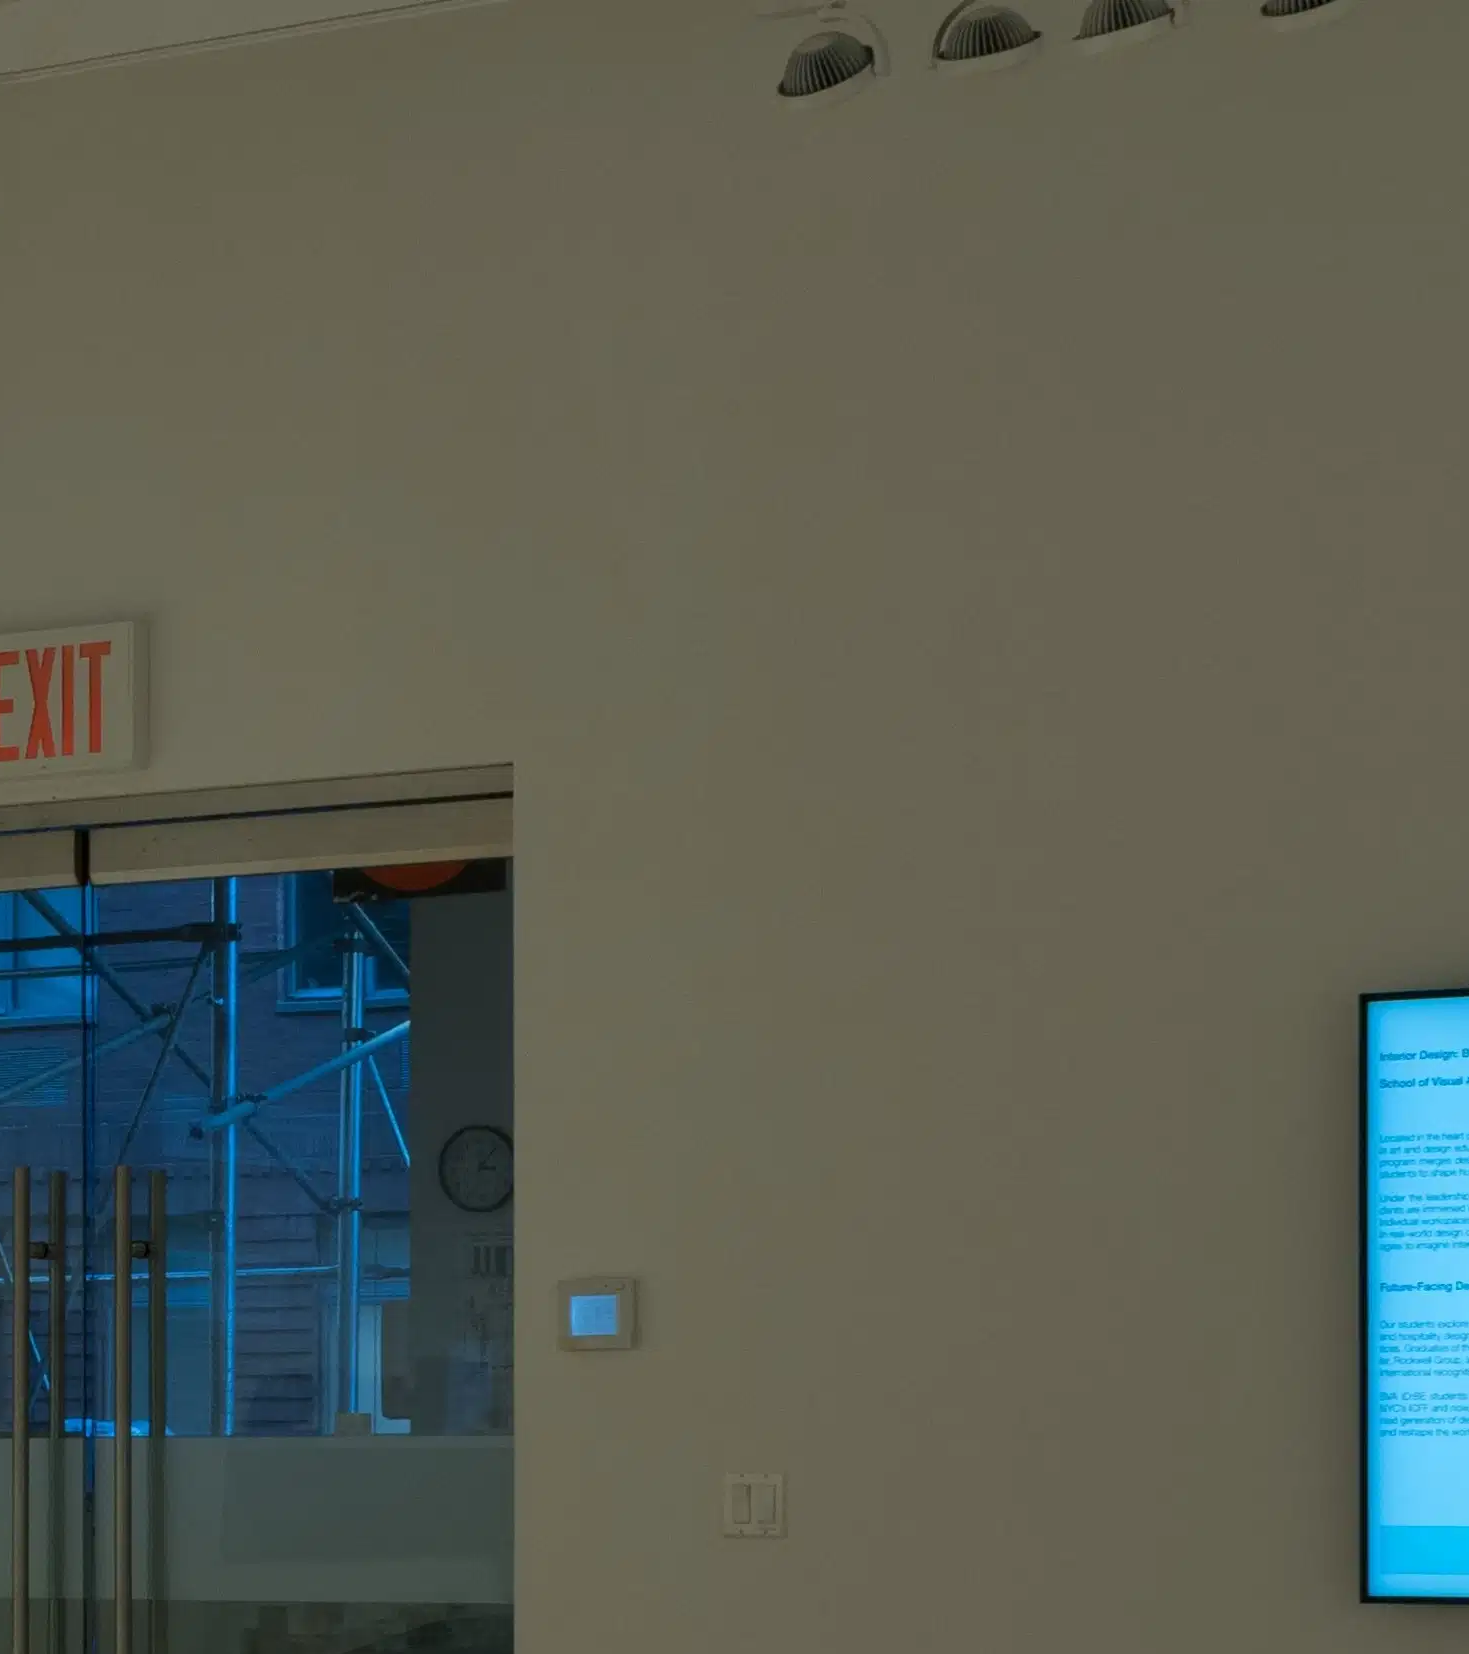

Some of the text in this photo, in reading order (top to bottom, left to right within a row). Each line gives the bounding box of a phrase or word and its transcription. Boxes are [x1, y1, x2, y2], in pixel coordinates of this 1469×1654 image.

[1379, 1078, 1415, 1088] School
[1418, 1077, 1429, 1087] of
[1431, 1076, 1463, 1086] Visual
